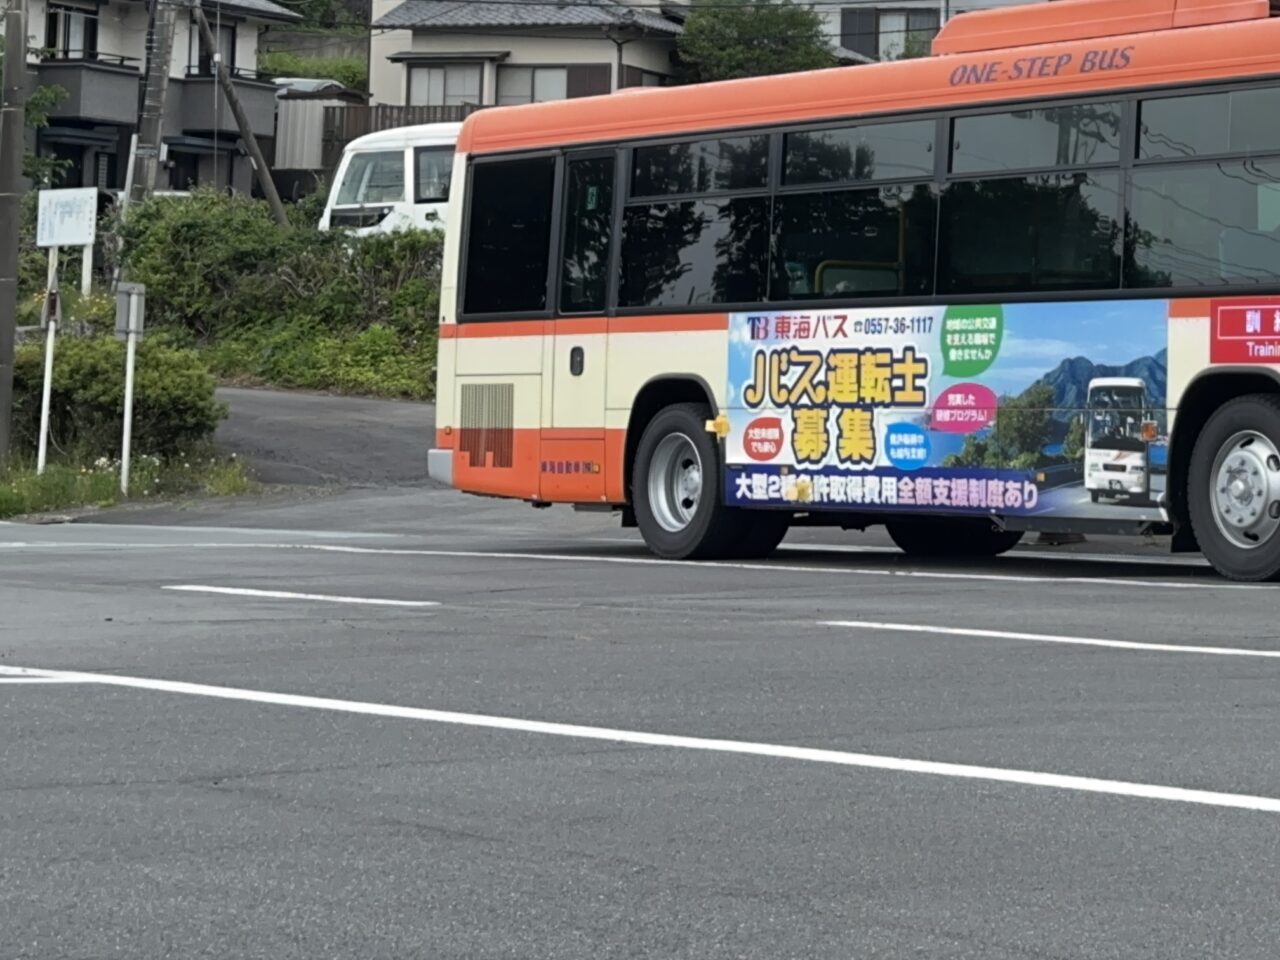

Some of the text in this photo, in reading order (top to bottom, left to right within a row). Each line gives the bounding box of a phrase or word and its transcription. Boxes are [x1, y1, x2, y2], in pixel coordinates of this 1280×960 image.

[950, 46, 1135, 86] ONE-STEP BUS
[775, 315, 848, 339] 東海バス
[744, 346, 928, 409] バス運転士
[791, 405, 877, 465] 募集
